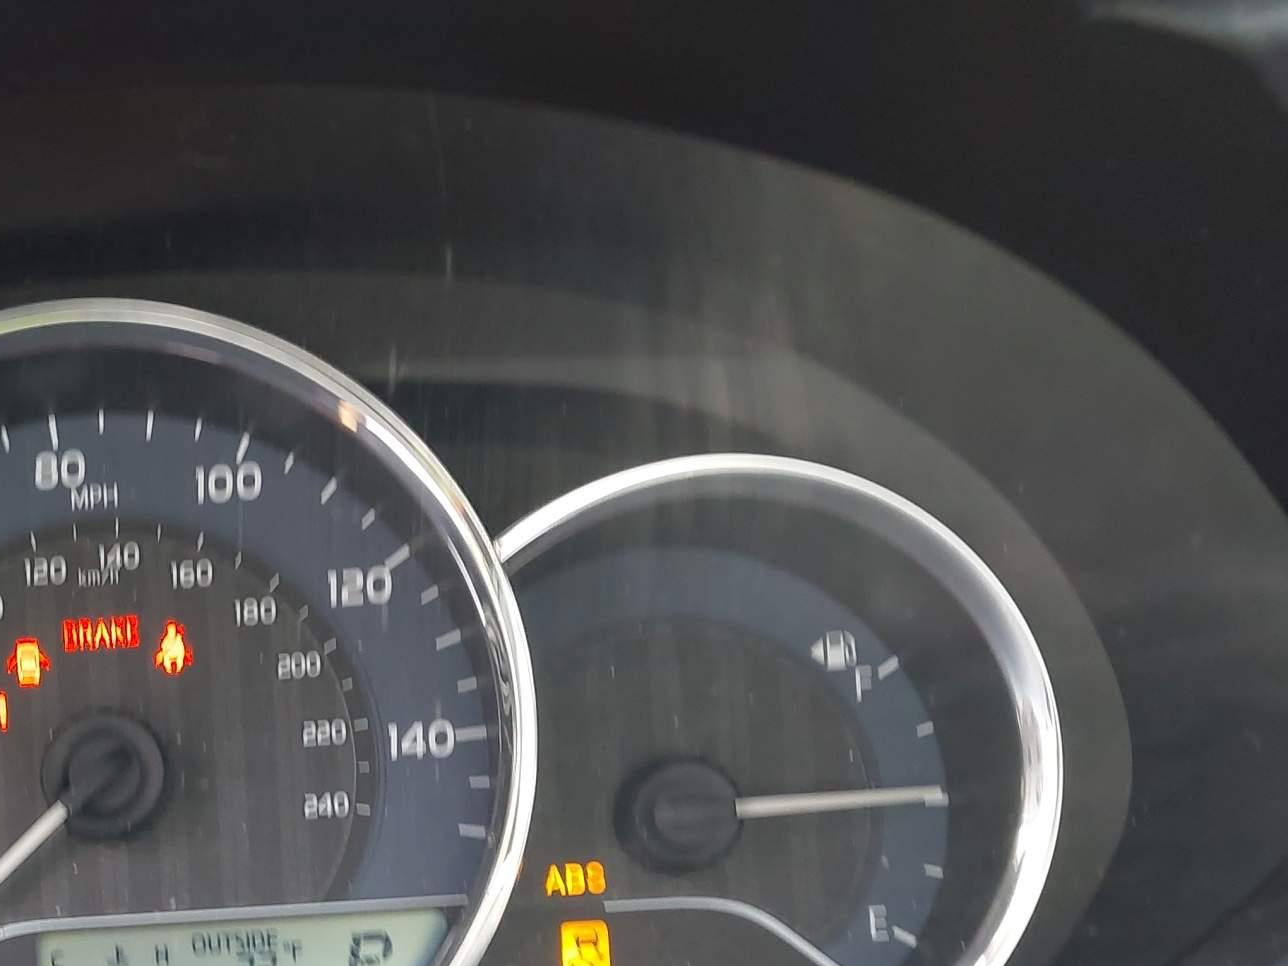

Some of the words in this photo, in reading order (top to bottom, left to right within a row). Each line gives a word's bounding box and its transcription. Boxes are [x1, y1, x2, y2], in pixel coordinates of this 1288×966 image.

[35, 450, 86, 490] 80
[196, 461, 262, 504] 100
[70, 482, 119, 512] MPH
[24, 556, 66, 587] 120
[99, 541, 140, 571] 140
[171, 558, 213, 589] 160
[327, 565, 392, 608] 120
[234, 597, 278, 627] 180
[63, 615, 140, 652] BRAKE
[278, 651, 321, 680] 200
[856, 664, 872, 702] F
[302, 719, 347, 748] 220
[387, 720, 455, 761] 140
[303, 791, 350, 821] 240
[545, 861, 607, 896] ABS
[868, 904, 890, 942] E
[155, 944, 170, 966] H
[191, 929, 278, 957] OUTSIDE
